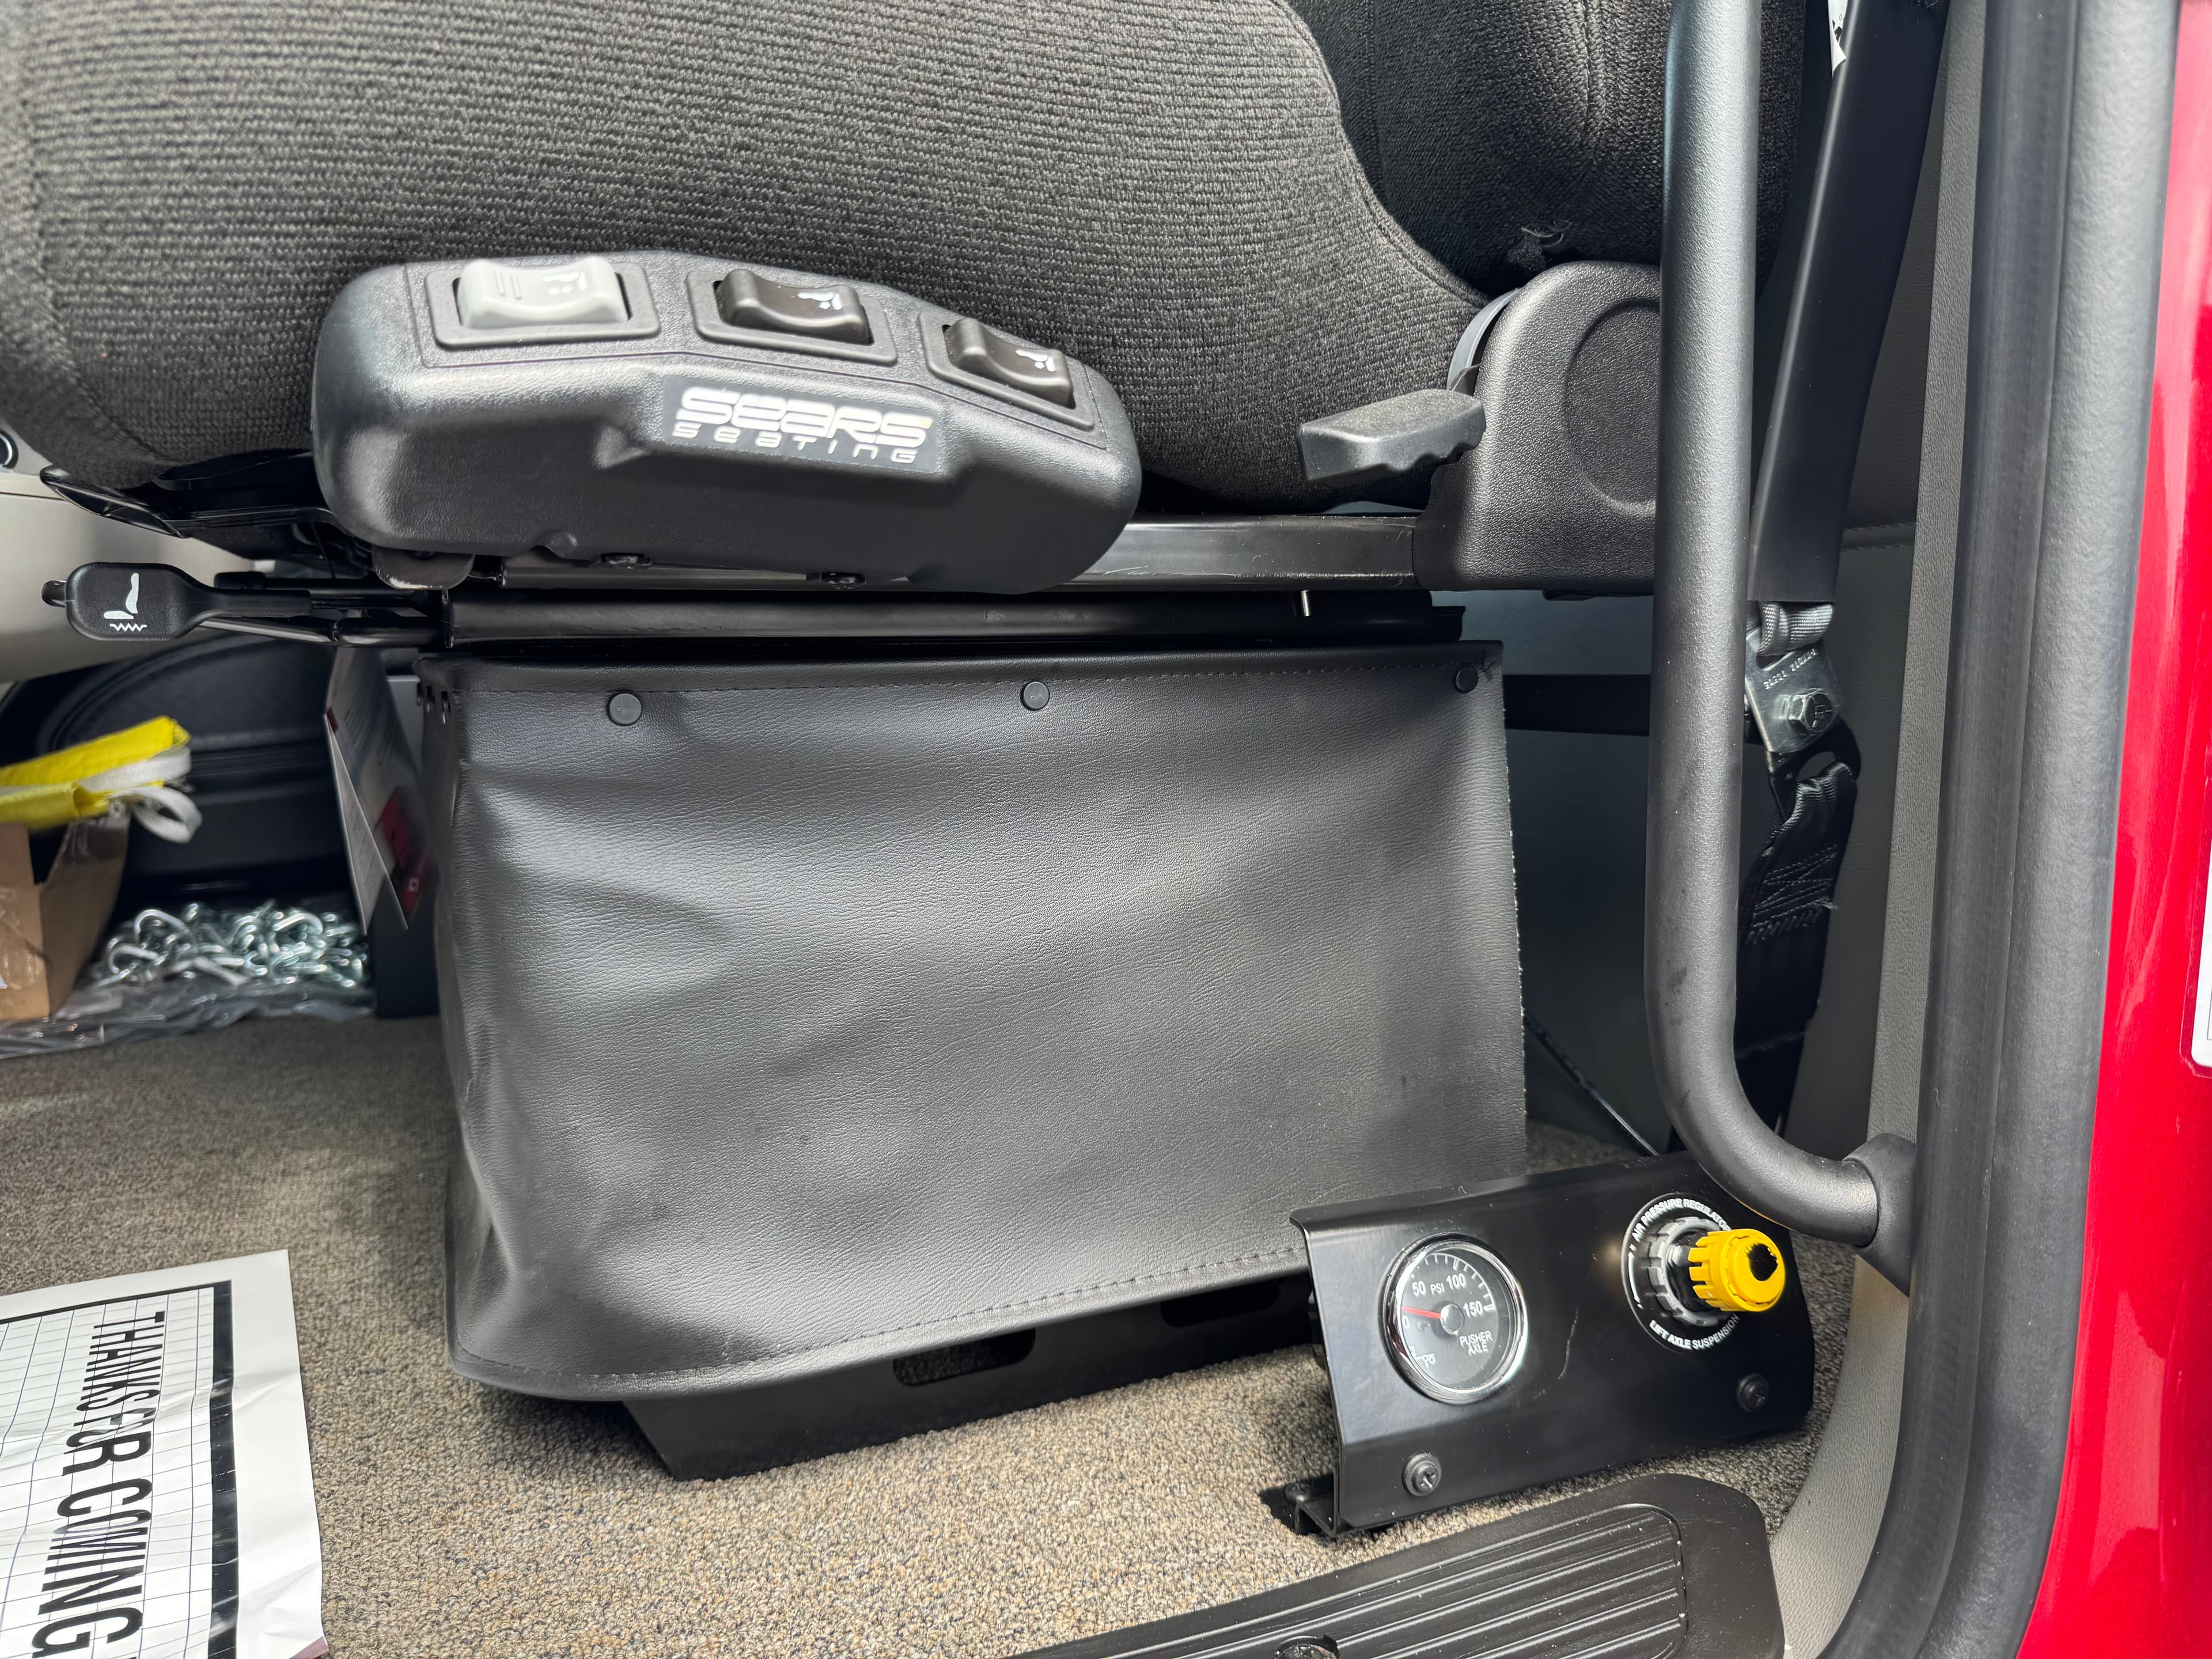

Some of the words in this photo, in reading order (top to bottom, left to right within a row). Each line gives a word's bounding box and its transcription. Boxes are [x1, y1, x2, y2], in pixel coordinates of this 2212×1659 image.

[1632, 1222, 1646, 1243] AIR
[1640, 1198, 1684, 1227] PRESSURE
[1412, 1281, 1426, 1297] 50
[1430, 1282, 1445, 1295] PSI
[1446, 1273, 1467, 1290] 100
[1463, 1301, 1484, 1318] 150
[1459, 1331, 1493, 1349] PUSHER
[1649, 1319, 1669, 1340] LIFT
[1667, 1334, 1692, 1350] AXLE
[1692, 1313, 1740, 1350] SUSPENSION
[76, 1310, 165, 1411] THANKS
[1468, 1342, 1488, 1355] AXLE
[32, 1478, 153, 1658] COMING
